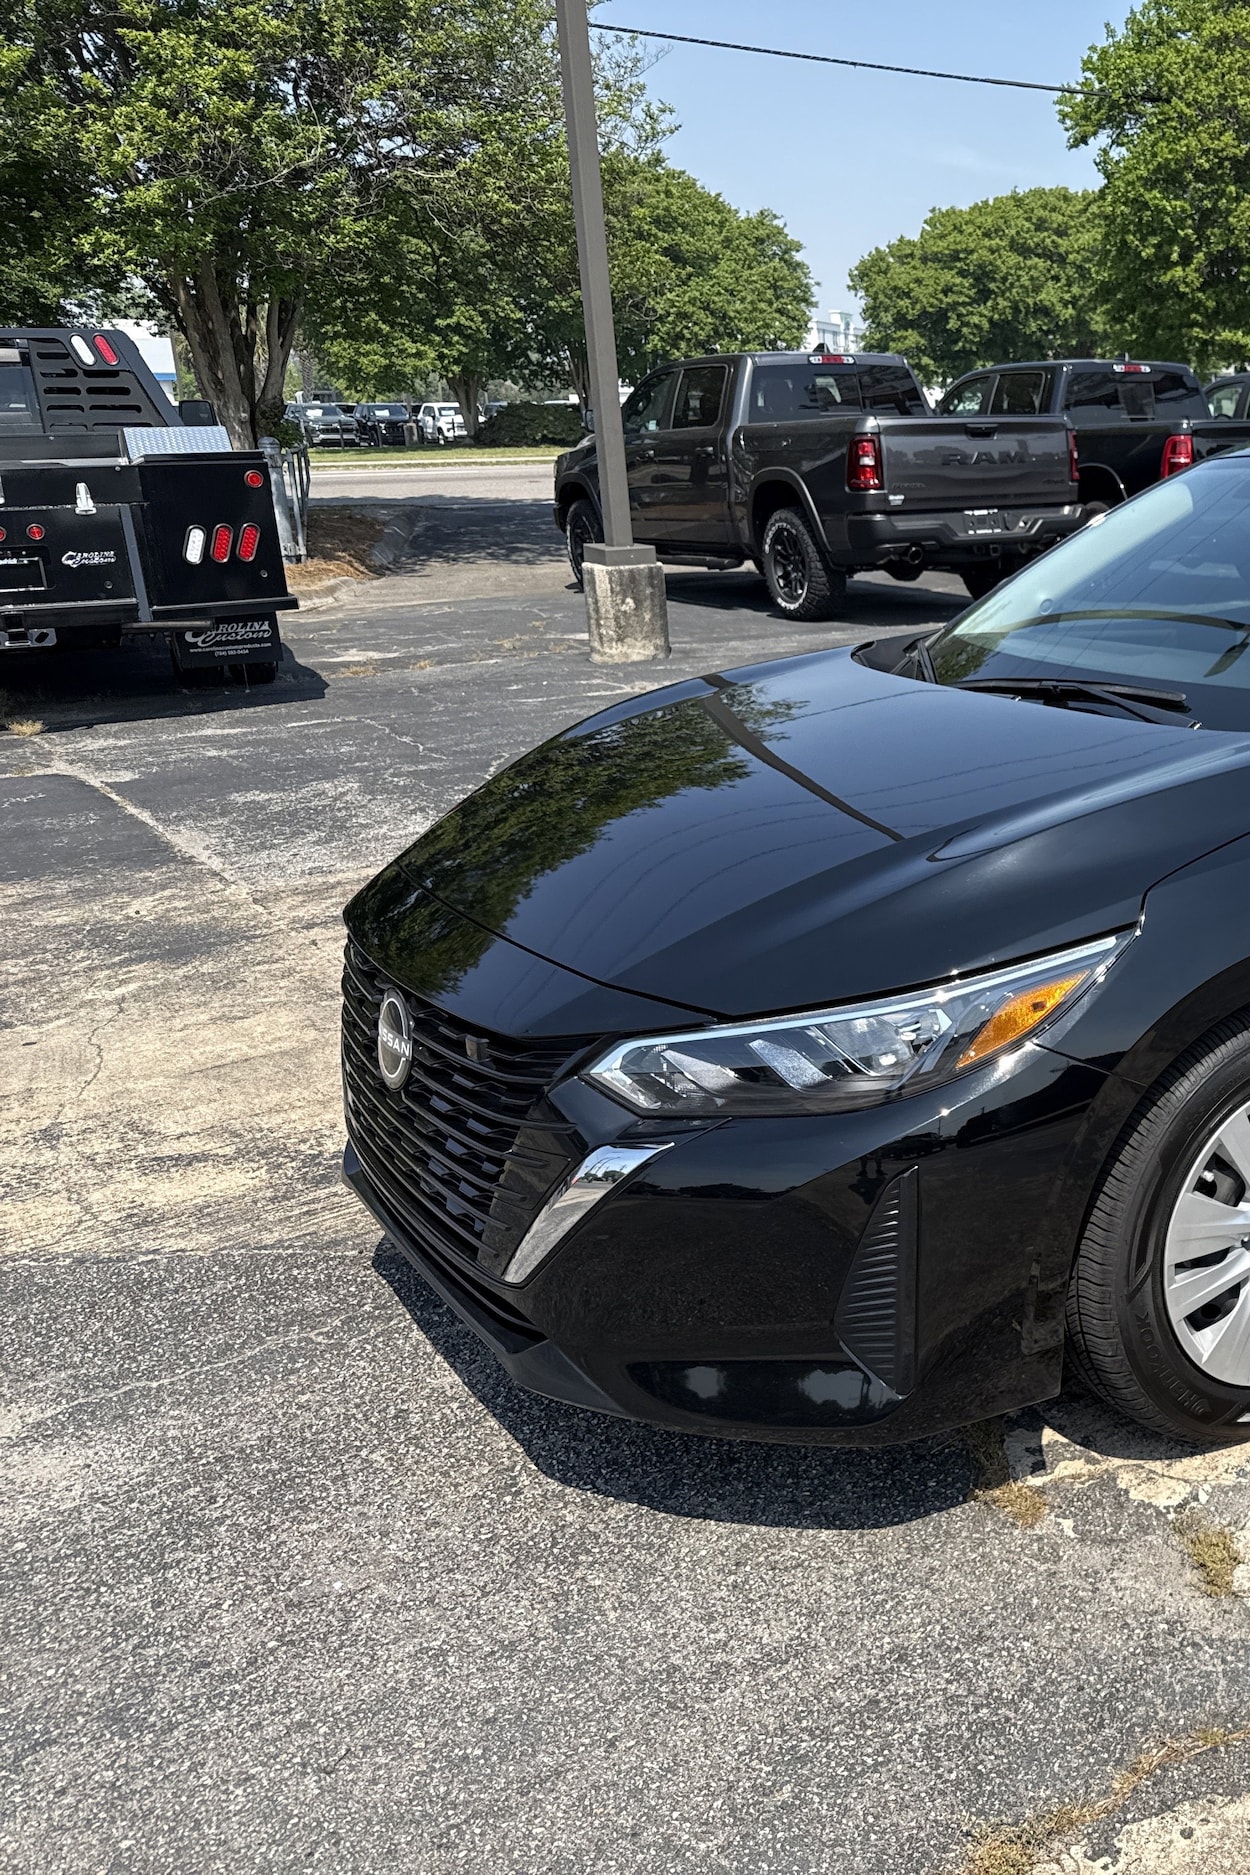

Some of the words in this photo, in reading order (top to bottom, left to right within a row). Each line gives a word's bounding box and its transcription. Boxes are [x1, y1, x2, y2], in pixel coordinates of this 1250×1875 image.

[941, 450, 1026, 466] RAM
[185, 621, 270, 643] CROLINA
[197, 630, 273, 648] Custom
[381, 1022, 410, 1058] SSAN
